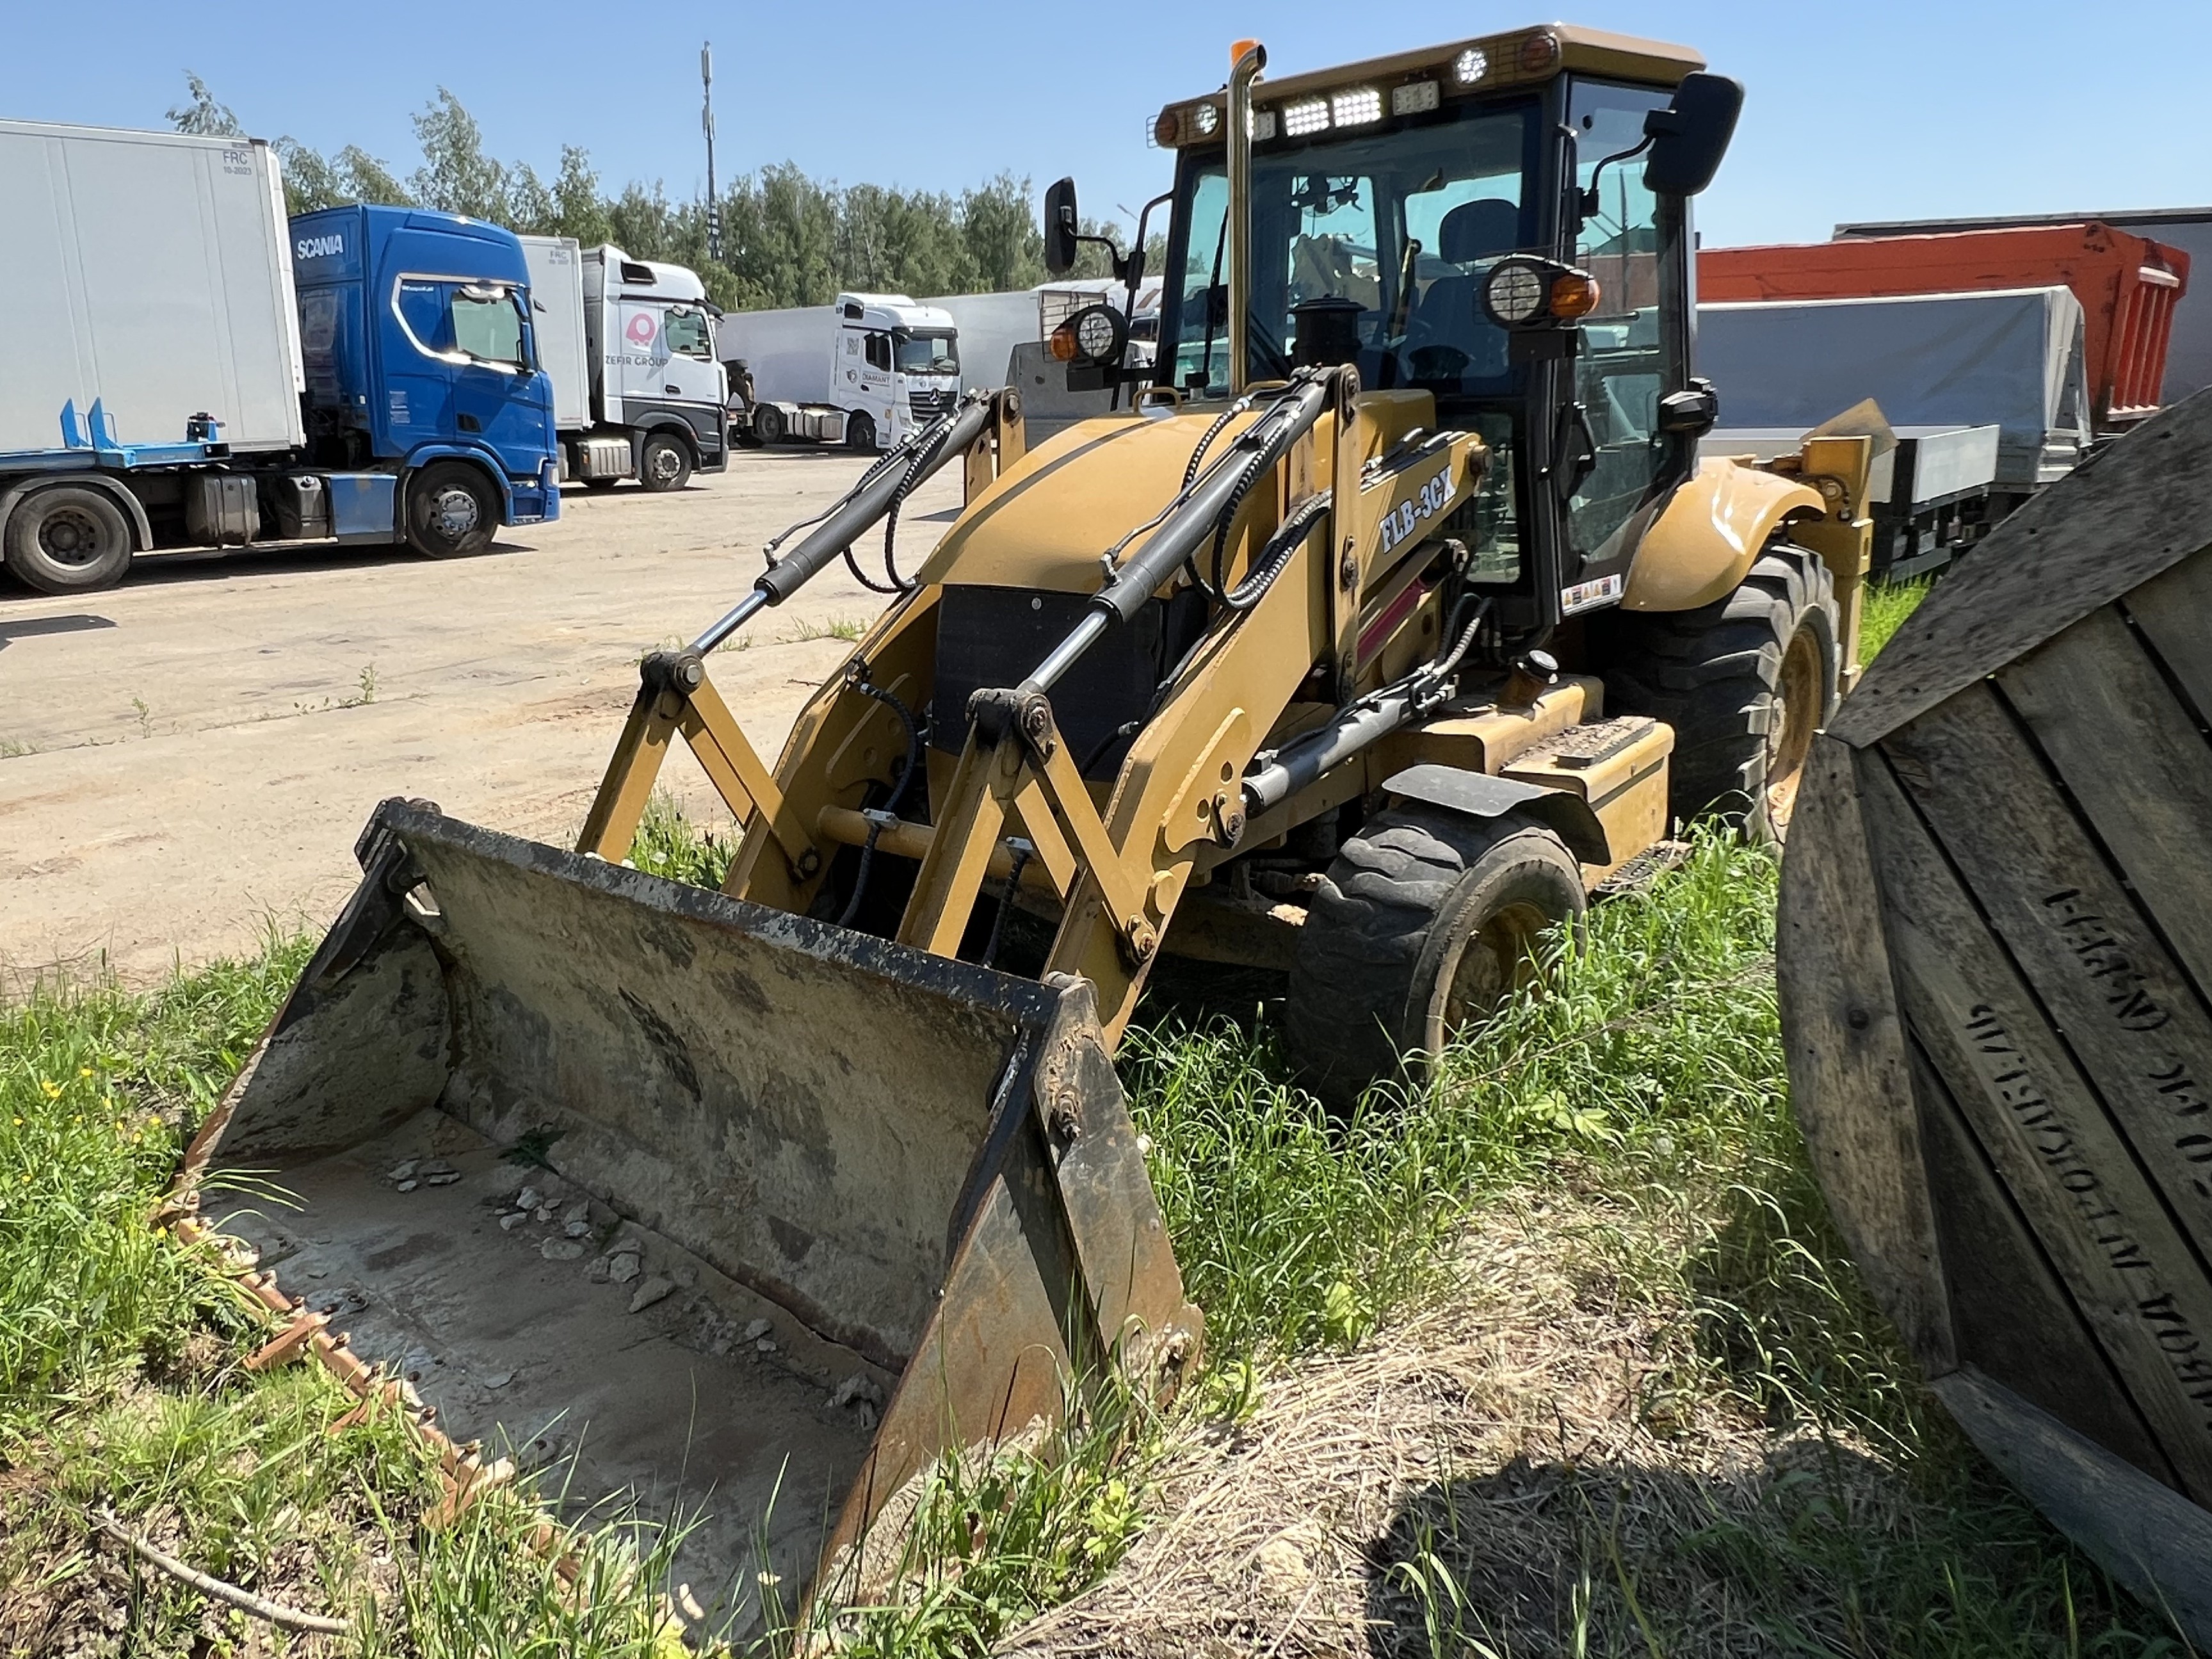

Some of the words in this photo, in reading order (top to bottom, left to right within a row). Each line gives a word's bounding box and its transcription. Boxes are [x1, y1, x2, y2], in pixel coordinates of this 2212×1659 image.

[223, 151, 248, 165] FRC
[298, 234, 344, 260] SCANIA
[606, 355, 631, 366] ZEFIR
[634, 356, 668, 367] GROUP
[862, 373, 891, 384] DIAMANT
[1379, 464, 1457, 554] FLB-3CX
[1966, 1004, 2152, 1269] АГРОКАБЕЛЬ
[2137, 1292, 2212, 1431] АВОД
